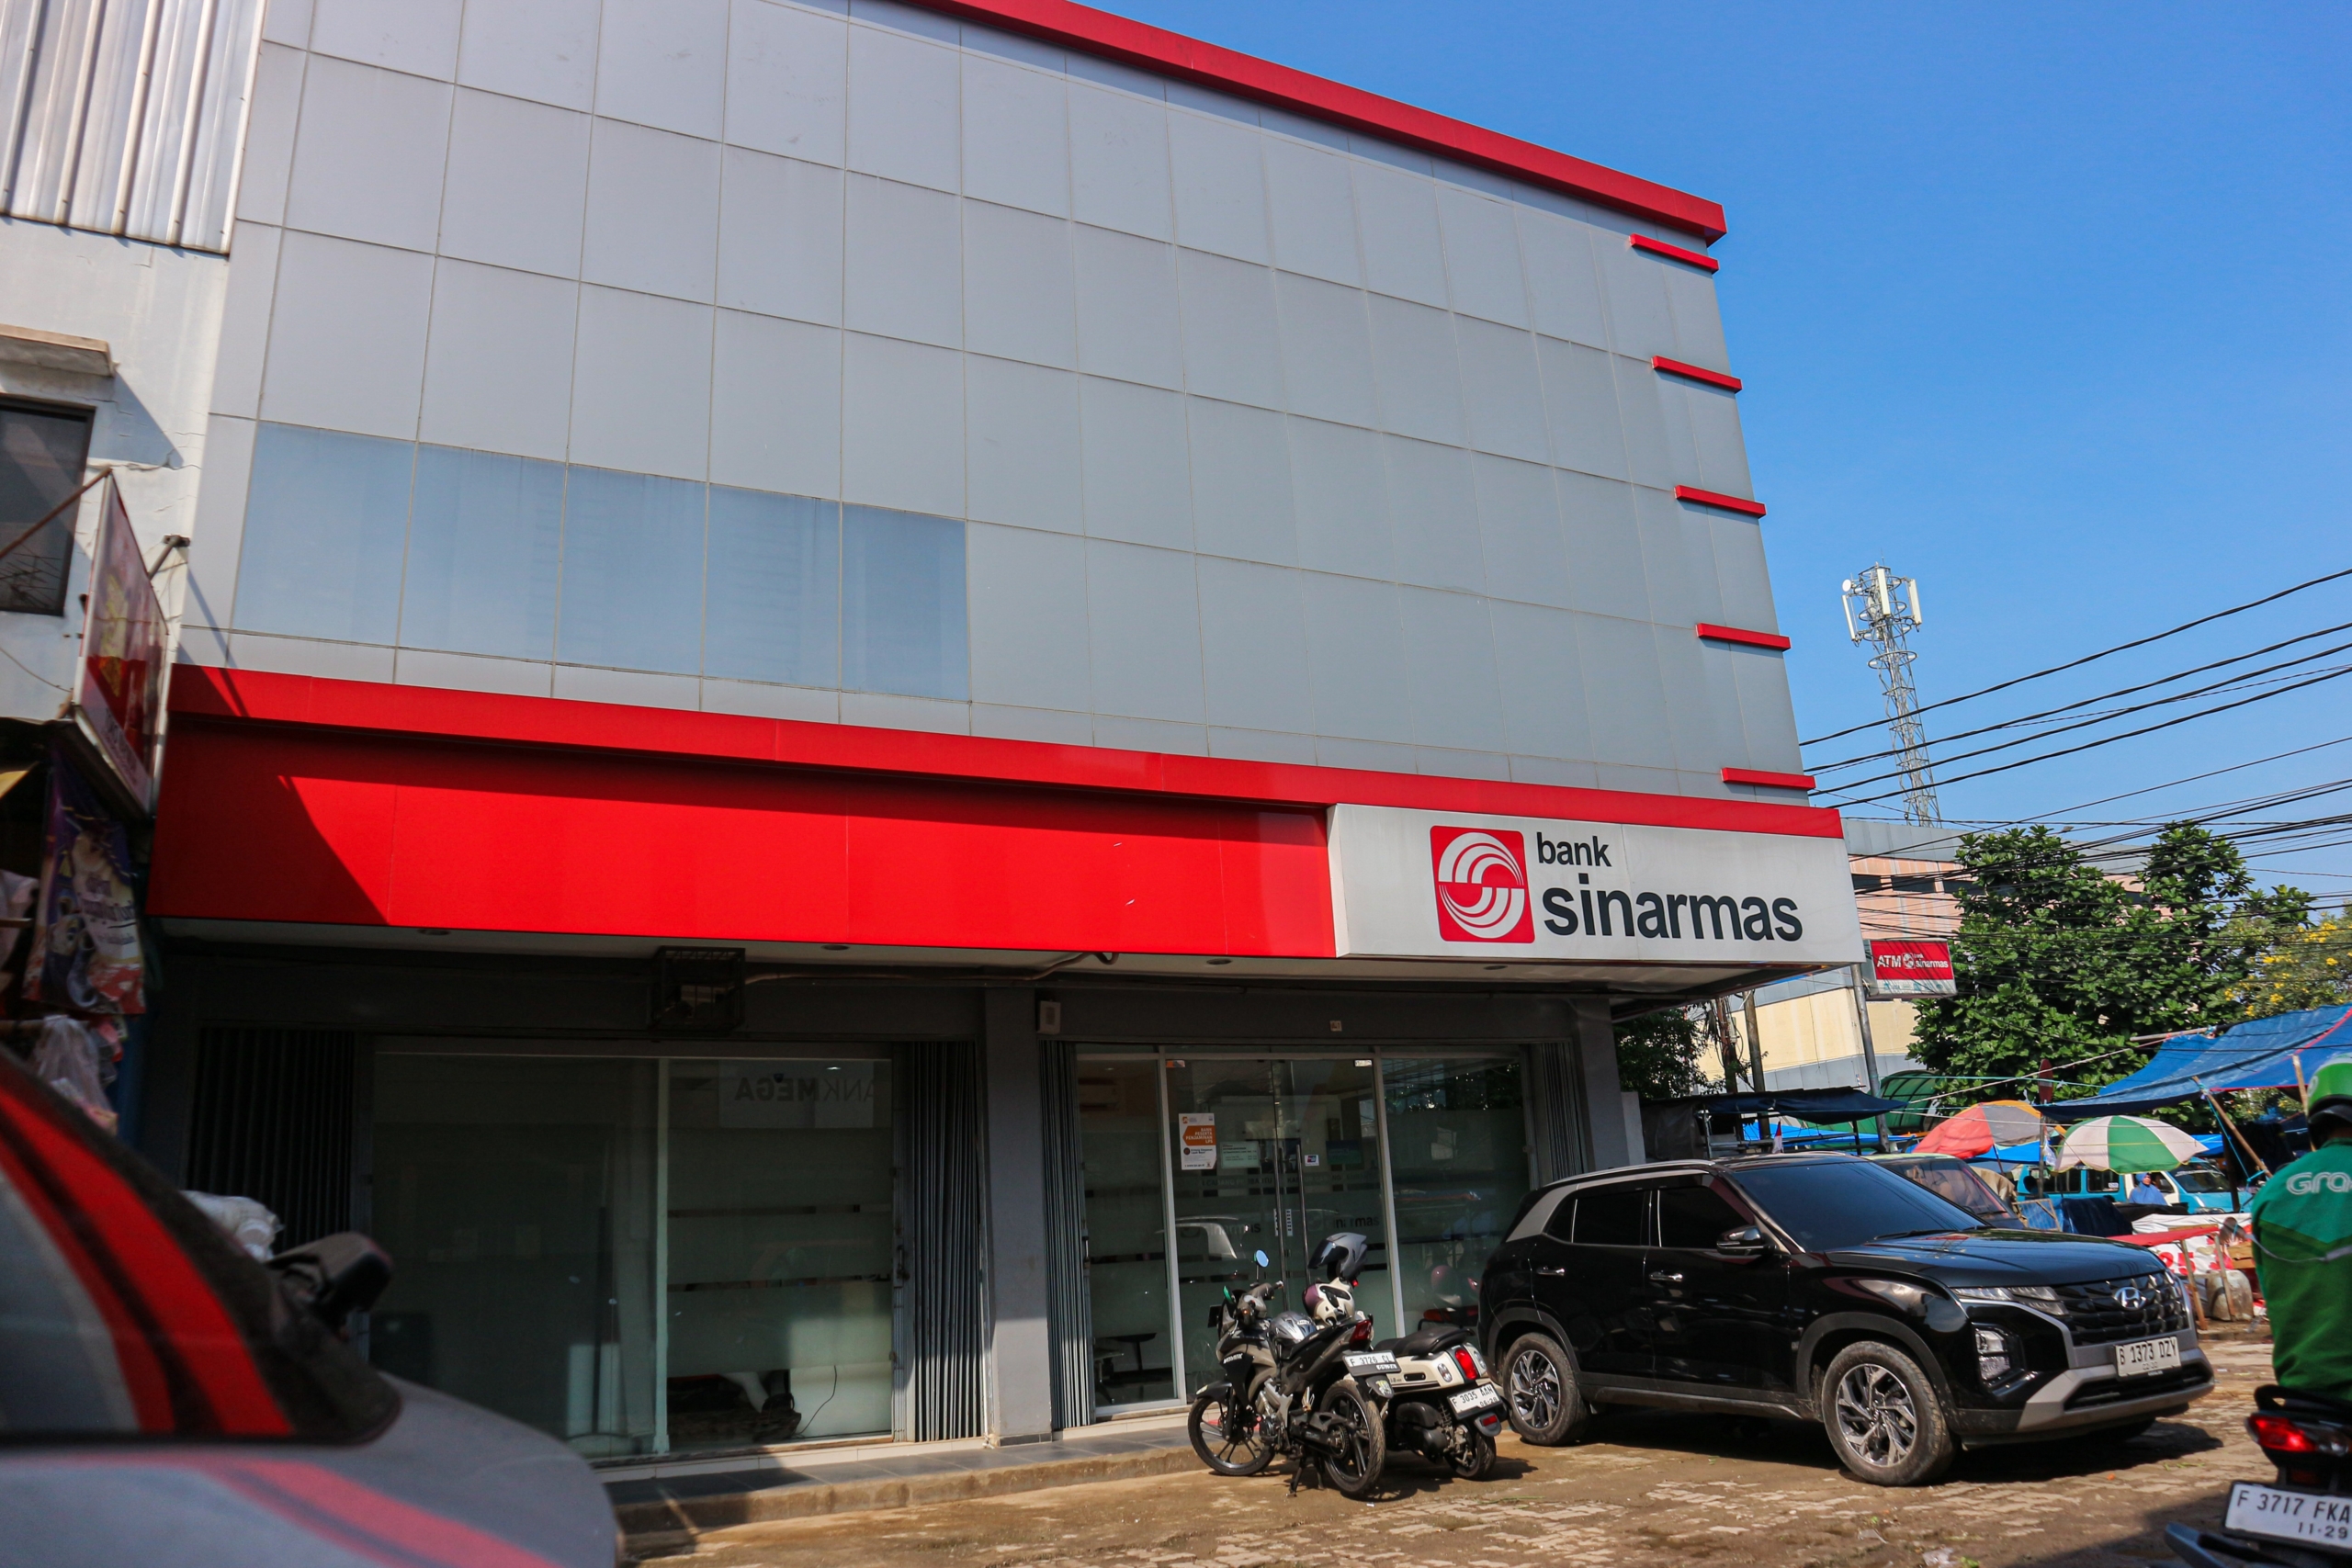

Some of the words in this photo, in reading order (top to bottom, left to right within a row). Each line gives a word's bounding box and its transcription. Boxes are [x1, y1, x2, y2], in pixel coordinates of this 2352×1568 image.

[1536, 831, 1611, 868] bank
[1543, 873, 1803, 942] sinarmas
[1876, 954, 1902, 968] ATM
[1916, 958, 1949, 968] sinarmas
[2286, 1171, 2352, 1195] Gra
[1350, 1358, 1355, 1366] F
[2119, 1348, 2126, 1365] B
[2130, 1343, 2154, 1363] 1373
[2158, 1338, 2177, 1358] DZY
[1452, 1398, 1457, 1407] F
[1460, 1391, 1478, 1404] 3035
[2237, 1490, 2249, 1506] F
[2256, 1494, 2304, 1516] 3717
[2312, 1501, 2350, 1524] FKA
